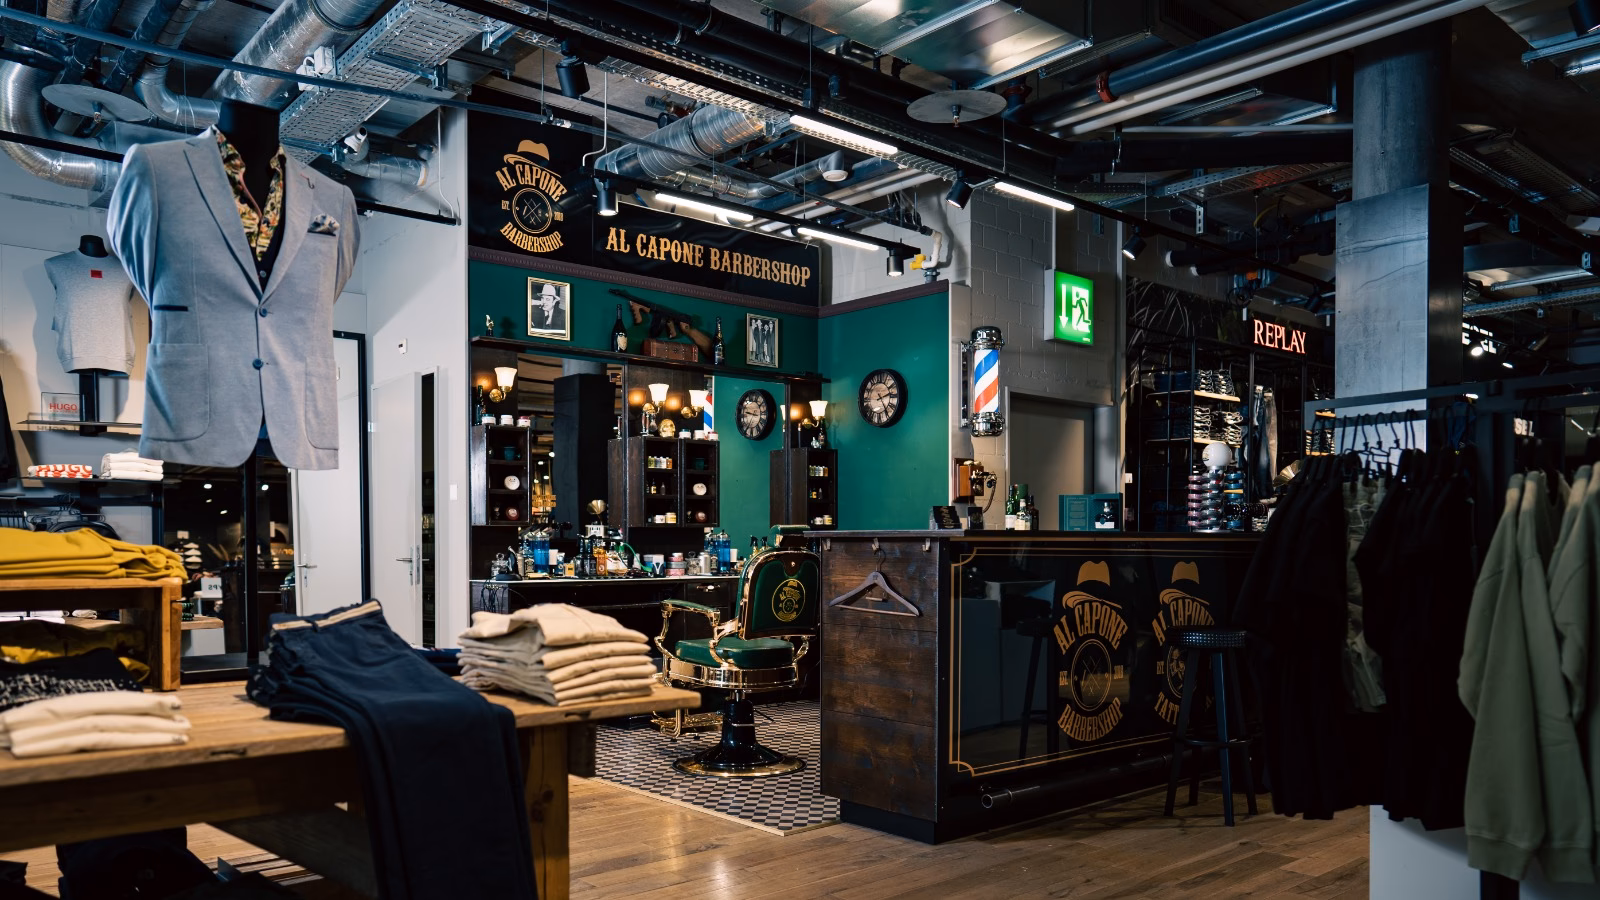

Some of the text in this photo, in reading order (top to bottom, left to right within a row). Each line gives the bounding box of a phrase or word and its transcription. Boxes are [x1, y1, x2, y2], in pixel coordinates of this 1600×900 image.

[495, 164, 567, 202] AL CAPONE
[500, 221, 564, 253] BARBERSHOP
[606, 227, 811, 287] AL CAPONE BARBERSHOP
[1254, 319, 1306, 354] REPLAY
[49, 402, 78, 411] HUGO
[1054, 602, 1128, 655] AL CAPONE
[1057, 697, 1123, 742] BARBERSHOP
